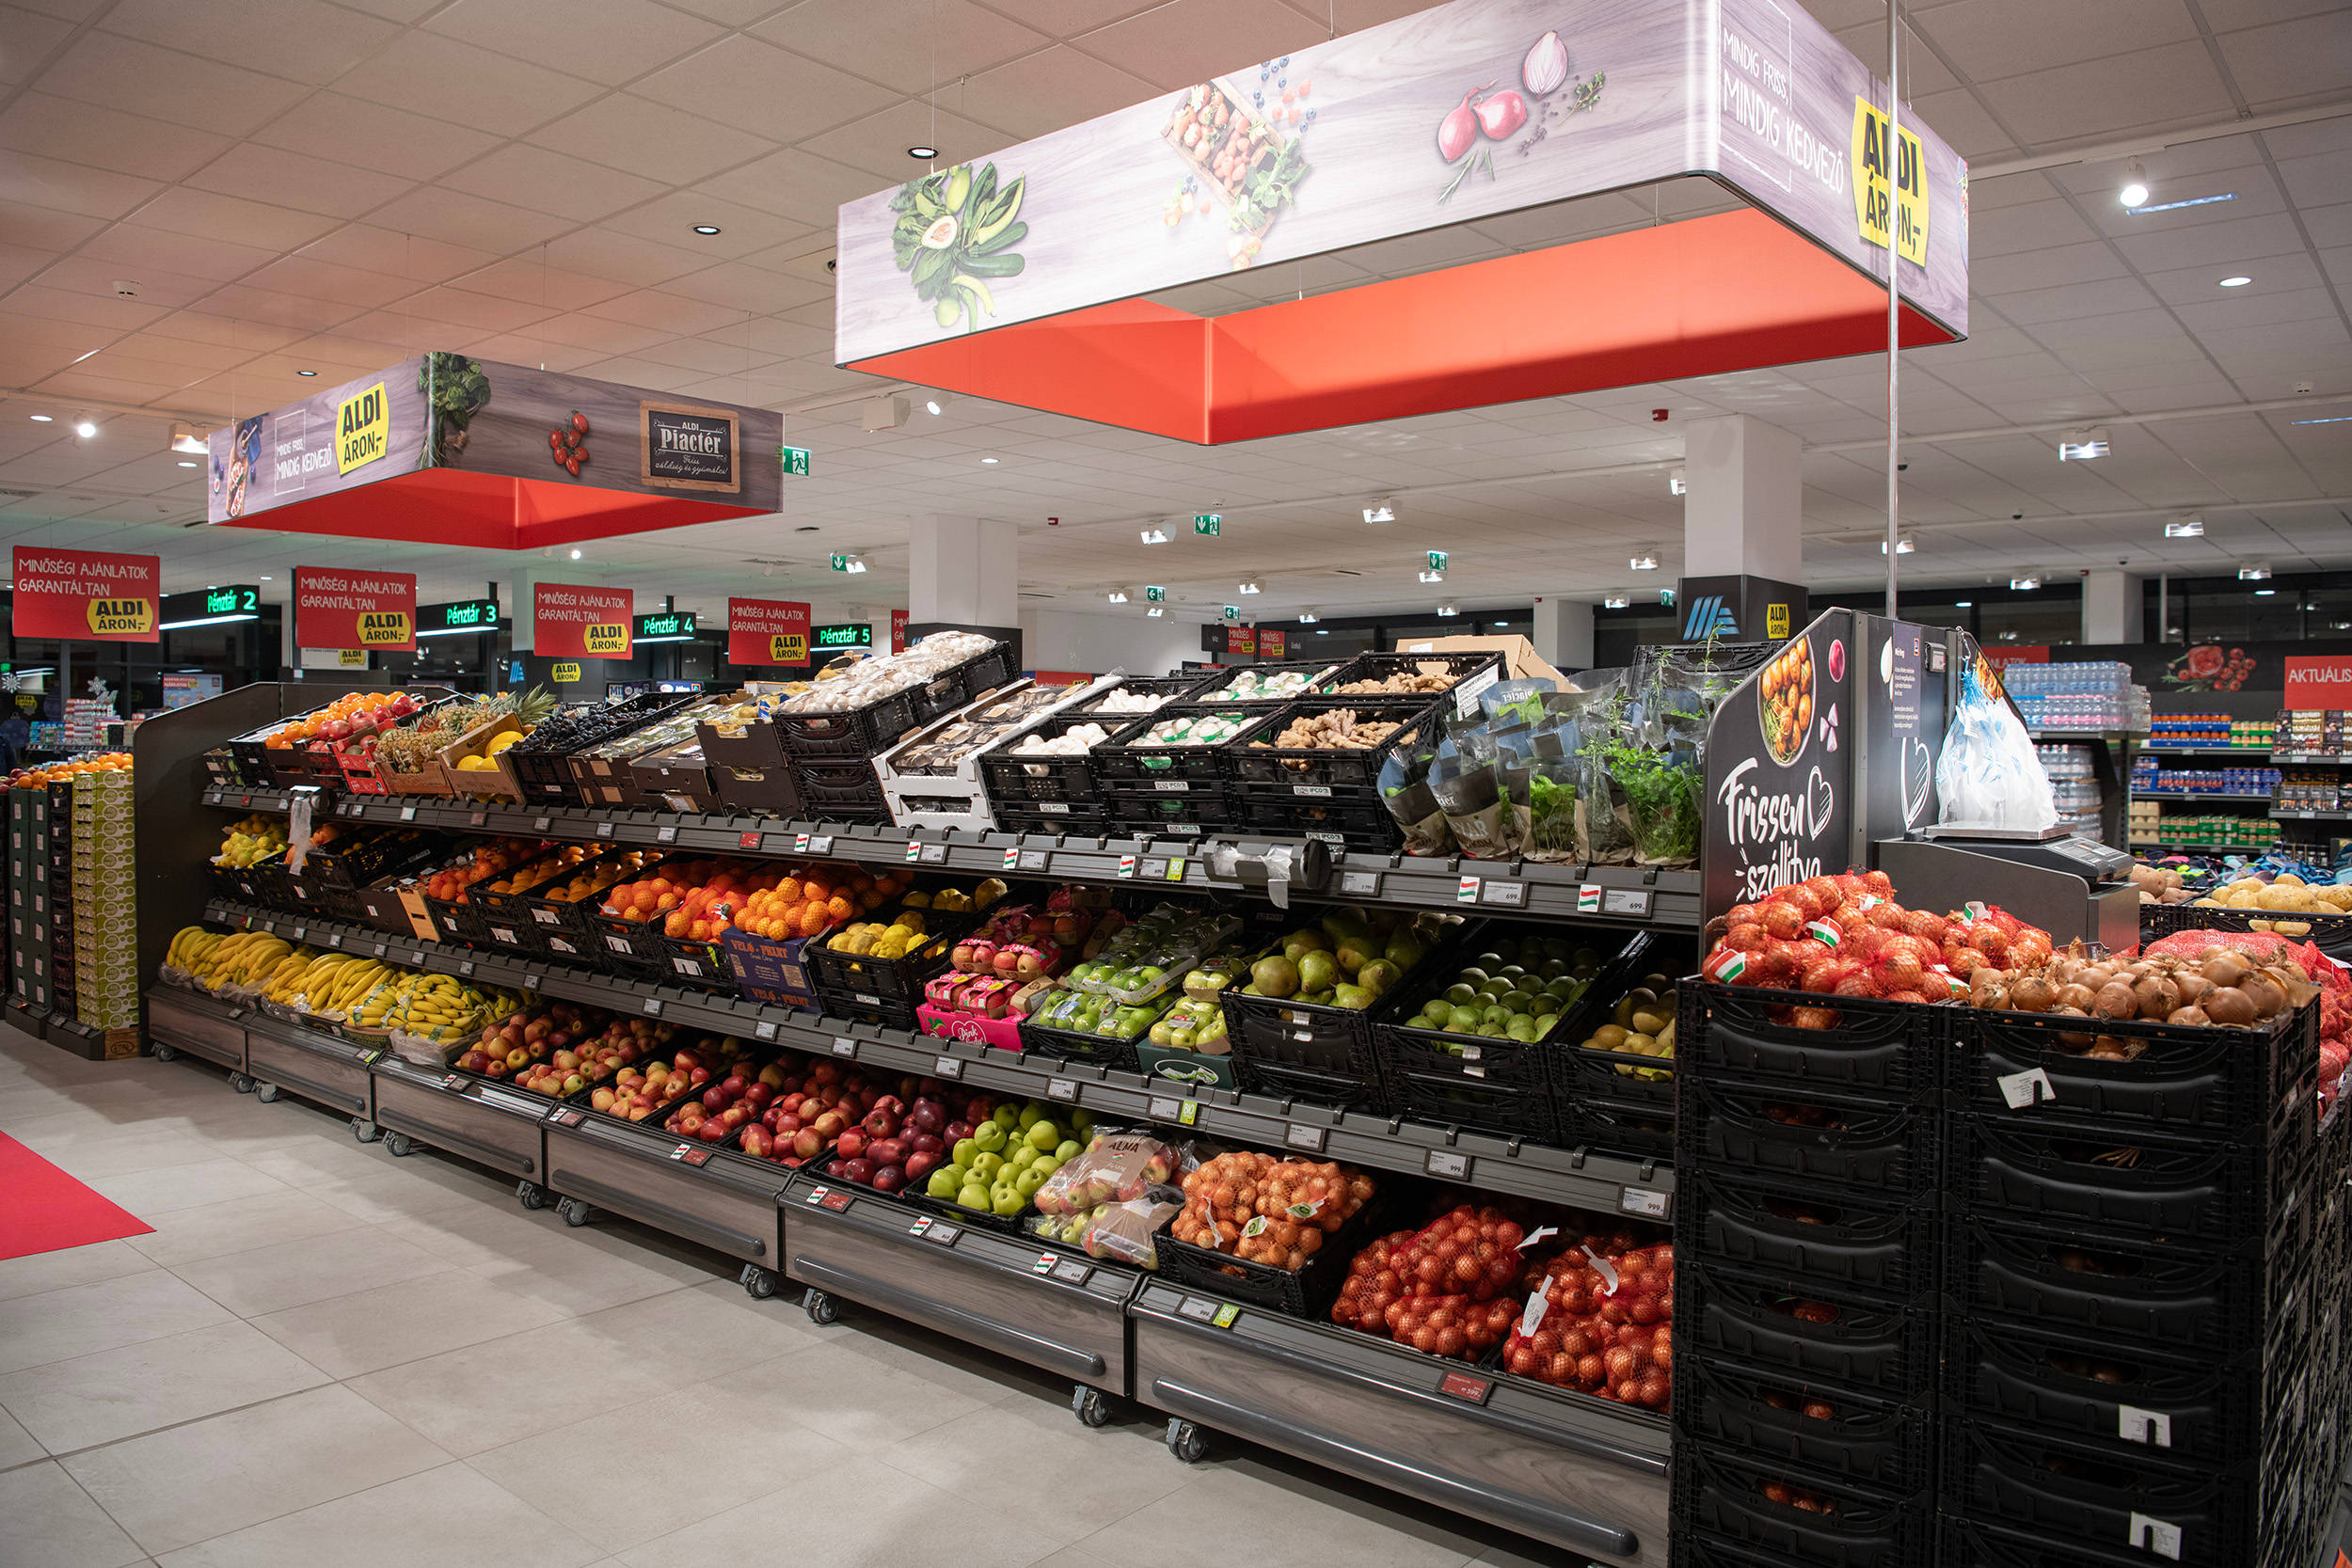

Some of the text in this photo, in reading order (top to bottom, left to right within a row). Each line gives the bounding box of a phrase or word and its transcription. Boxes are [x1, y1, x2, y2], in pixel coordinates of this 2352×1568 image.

[1724, 26, 1758, 78] MINDIG
[1724, 69, 1844, 195] MINDIG KEDVEZŐ
[1866, 171, 1921, 256] ÁRN,-
[342, 389, 380, 436] ALDI
[682, 421, 699, 431] ALDI
[660, 428, 721, 453] Piactér
[277, 456, 300, 481] MINDIG
[19, 558, 149, 579] MINŐSÉGI AJÁNLATOK
[19, 578, 110, 596] GARANTÁLTAN
[301, 576, 406, 595] MINŐSÉGI AJÁNLATOK
[96, 601, 143, 616] ALDI
[207, 589, 257, 613] Pénztár 2
[301, 594, 375, 610] GARANTÁLTAN
[538, 593, 625, 609] MINŐSÉGI AJÁNLATOK
[364, 614, 403, 627] ALDI
[447, 603, 497, 625] Pénztár 3
[538, 609, 600, 624] GARANTÁLTAN
[766, 609, 804, 621] AJÁNLATOK
[1771, 607, 1787, 621] ALDI
[590, 626, 622, 639] ALDI
[644, 613, 693, 635] Pénztár 4
[732, 621, 783, 633] GARANTÁLTAN
[774, 635, 802, 648] ALDI
[820, 624, 870, 644] Pénztár 5
[555, 664, 577, 673] ALDI
[2288, 666, 2352, 683] AKTUÁLIS
[1717, 756, 1804, 846] Frissen
[958, 1024, 978, 1041] Pink
[1184, 1102, 1195, 1115] BIO
[1107, 1141, 1140, 1152] ALMA
[1220, 1307, 1235, 1319] BIO
